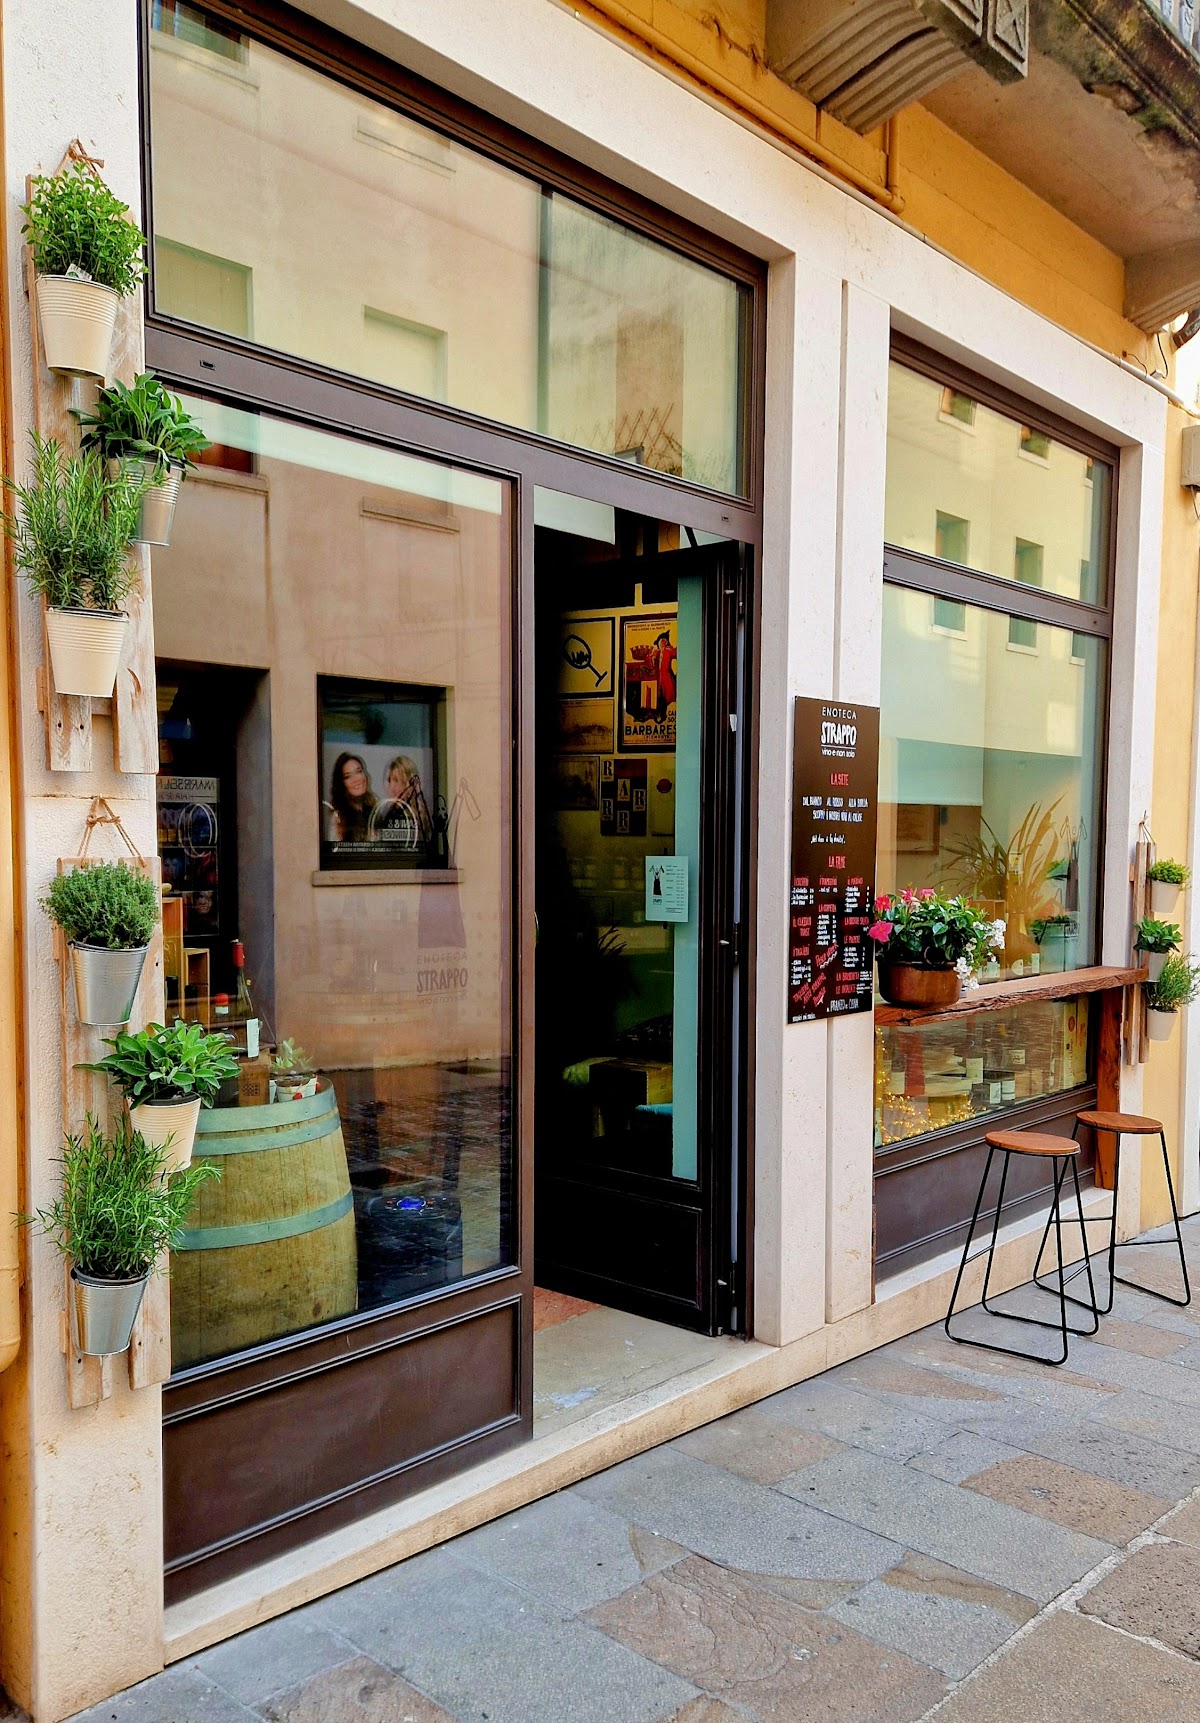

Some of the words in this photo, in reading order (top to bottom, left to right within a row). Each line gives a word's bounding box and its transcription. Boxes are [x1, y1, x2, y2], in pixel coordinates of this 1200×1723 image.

[822, 706, 857, 719] ENOTECA
[821, 721, 857, 746] STRAPPO
[821, 748, 832, 756] vino
[846, 750, 856, 758] solo
[830, 773, 838, 786] LA
[838, 774, 849, 786] SETE
[828, 856, 835, 868] LA
[417, 952, 468, 965] ENOTECA
[416, 967, 469, 993] STRAPPO
